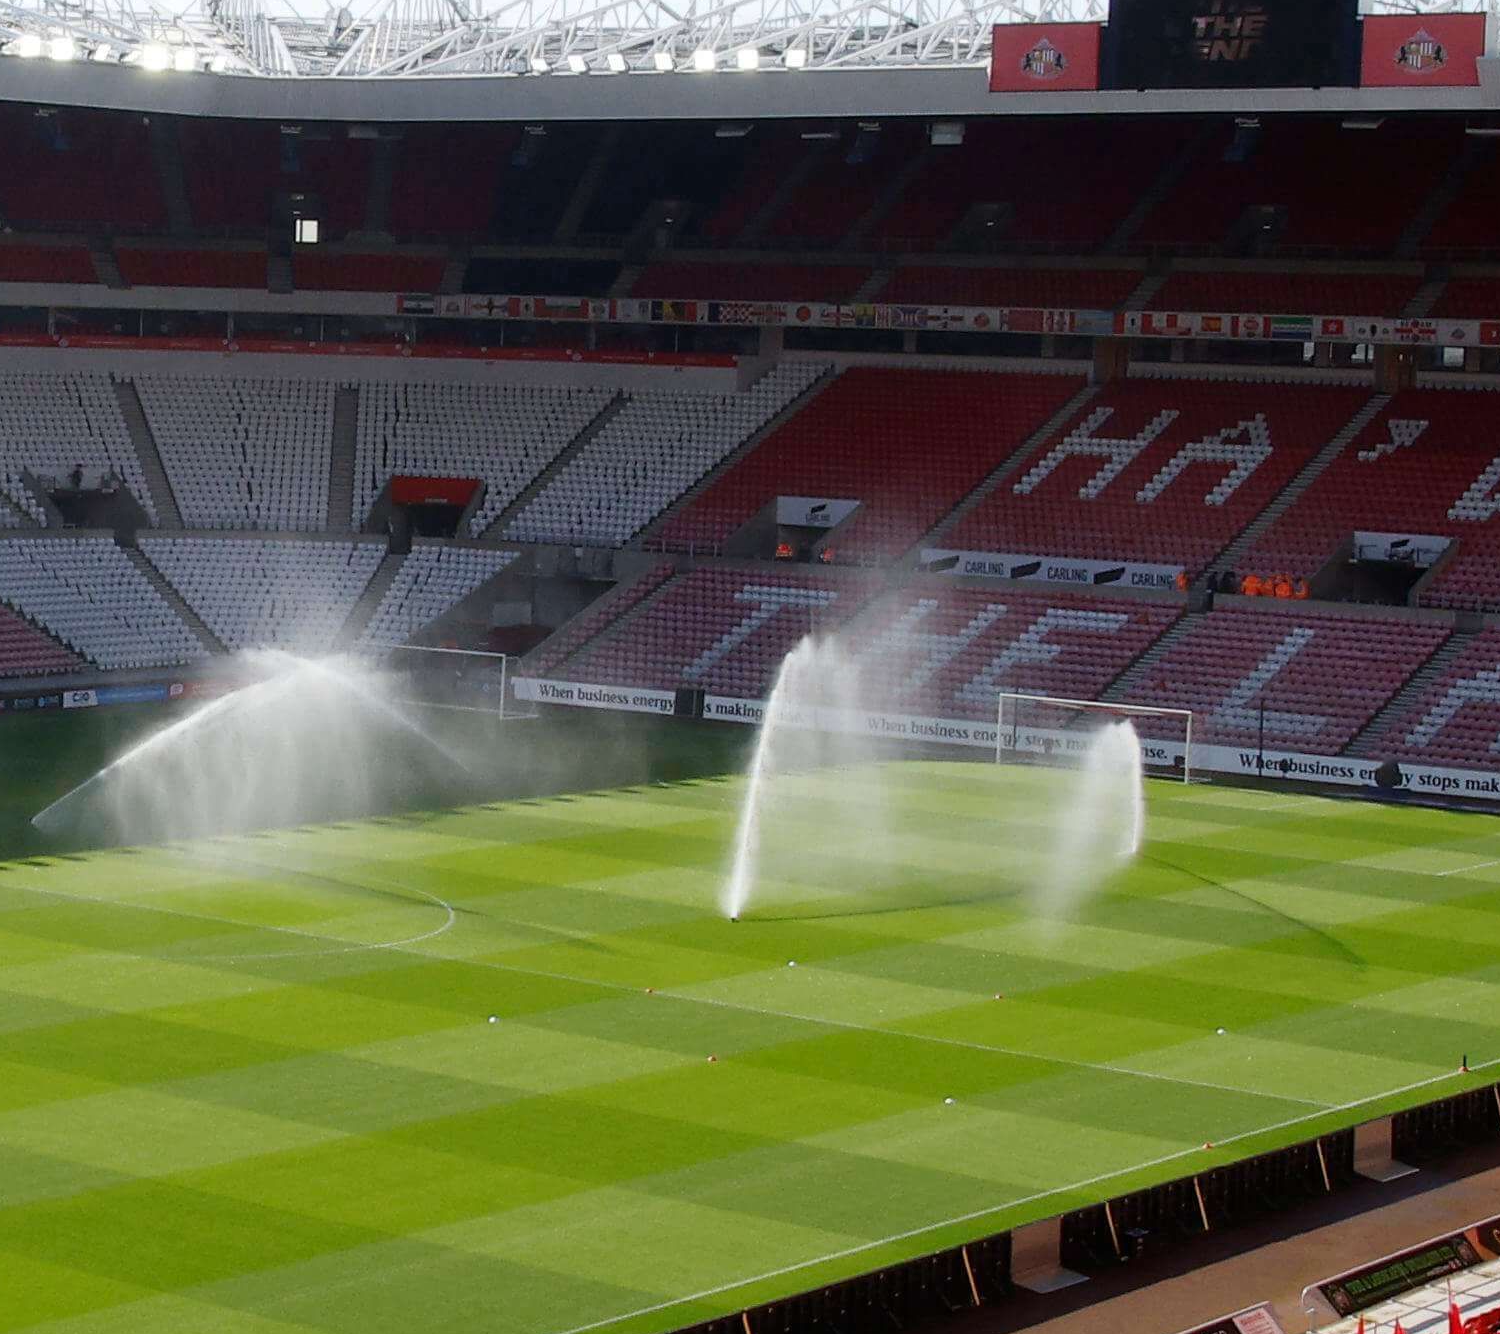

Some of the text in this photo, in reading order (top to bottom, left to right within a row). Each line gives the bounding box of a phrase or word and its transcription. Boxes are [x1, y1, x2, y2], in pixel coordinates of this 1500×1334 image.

[1192, 14, 1268, 38] THE
[964, 560, 1005, 575] CARLING
[1046, 568, 1088, 582] CARLING
[1131, 573, 1174, 588] CARLING
[682, 584, 1129, 704] THE
[539, 684, 574, 703] When
[577, 688, 629, 709] business
[632, 695, 675, 713] energy
[718, 698, 764, 719] making
[866, 716, 907, 734] When
[911, 719, 971, 741] business
[1288, 757, 1353, 780] business
[1418, 769, 1461, 792] stops
